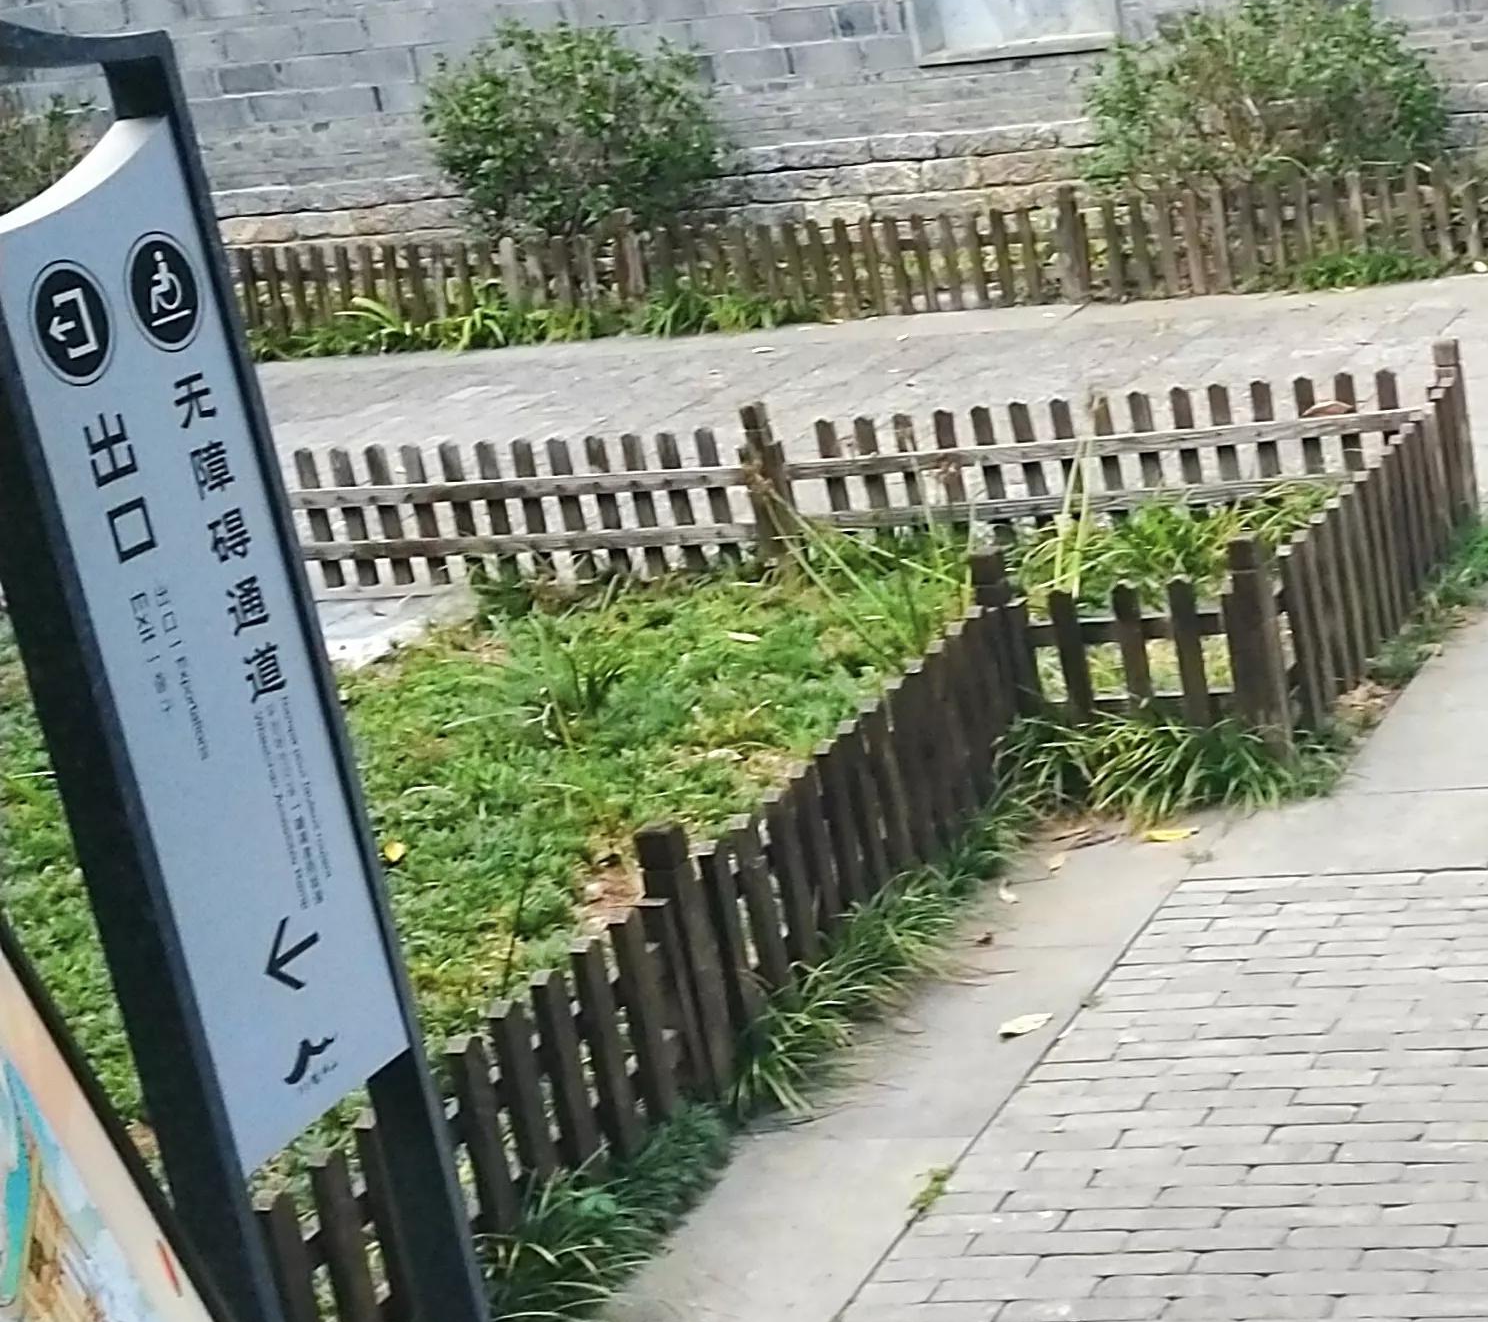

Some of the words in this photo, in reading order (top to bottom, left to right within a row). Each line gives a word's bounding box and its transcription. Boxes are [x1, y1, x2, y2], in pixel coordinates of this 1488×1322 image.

[83, 412, 159, 565] 出口
[173, 371, 286, 704] 无障碍通道
